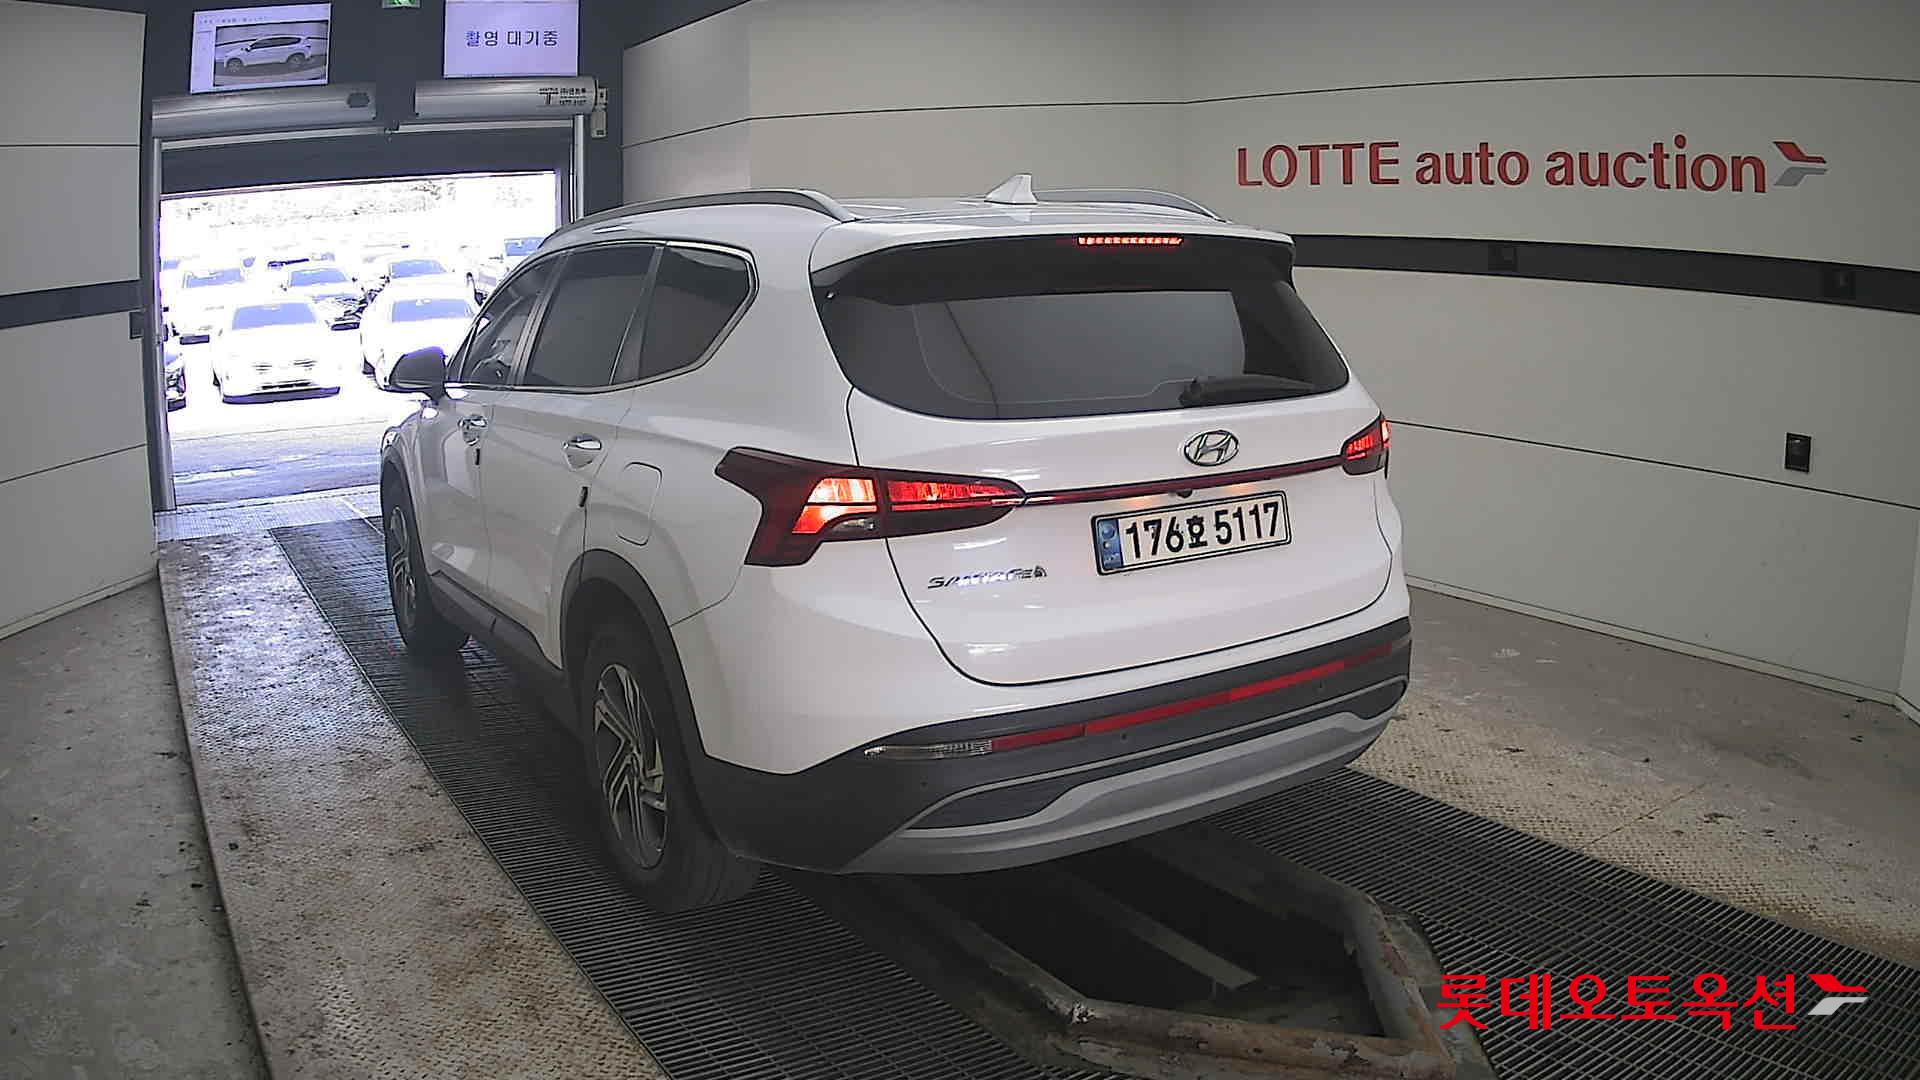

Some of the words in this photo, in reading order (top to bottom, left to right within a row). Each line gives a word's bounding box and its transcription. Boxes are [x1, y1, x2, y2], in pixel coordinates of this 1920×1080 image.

[507, 31, 558, 46] 대기중
[1237, 142, 1400, 188] LOTTE
[1416, 142, 1530, 187] auto
[1546, 135, 1766, 193] auction
[1215, 501, 1279, 544] 5117
